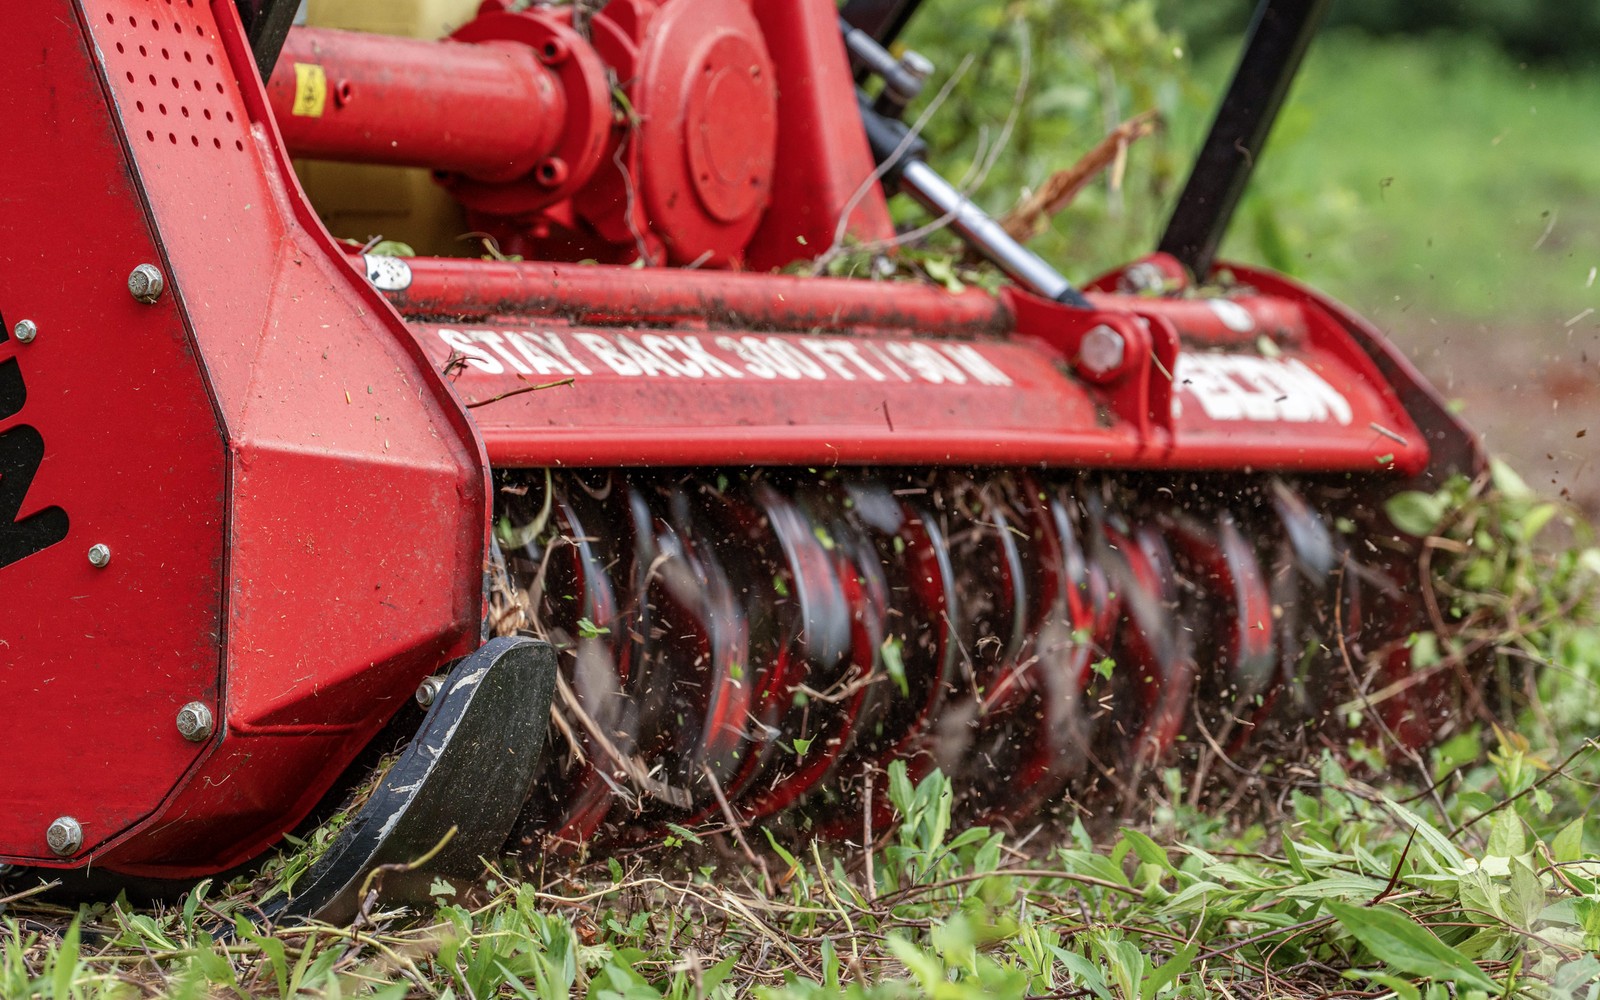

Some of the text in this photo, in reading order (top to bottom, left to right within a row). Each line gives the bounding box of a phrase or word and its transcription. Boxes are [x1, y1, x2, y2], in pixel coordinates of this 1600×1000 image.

[438, 329, 592, 375] STAY
[572, 332, 744, 378] BACK
[714, 336, 827, 380] 300
[800, 338, 887, 381] FT
[886, 341, 967, 384] 90
